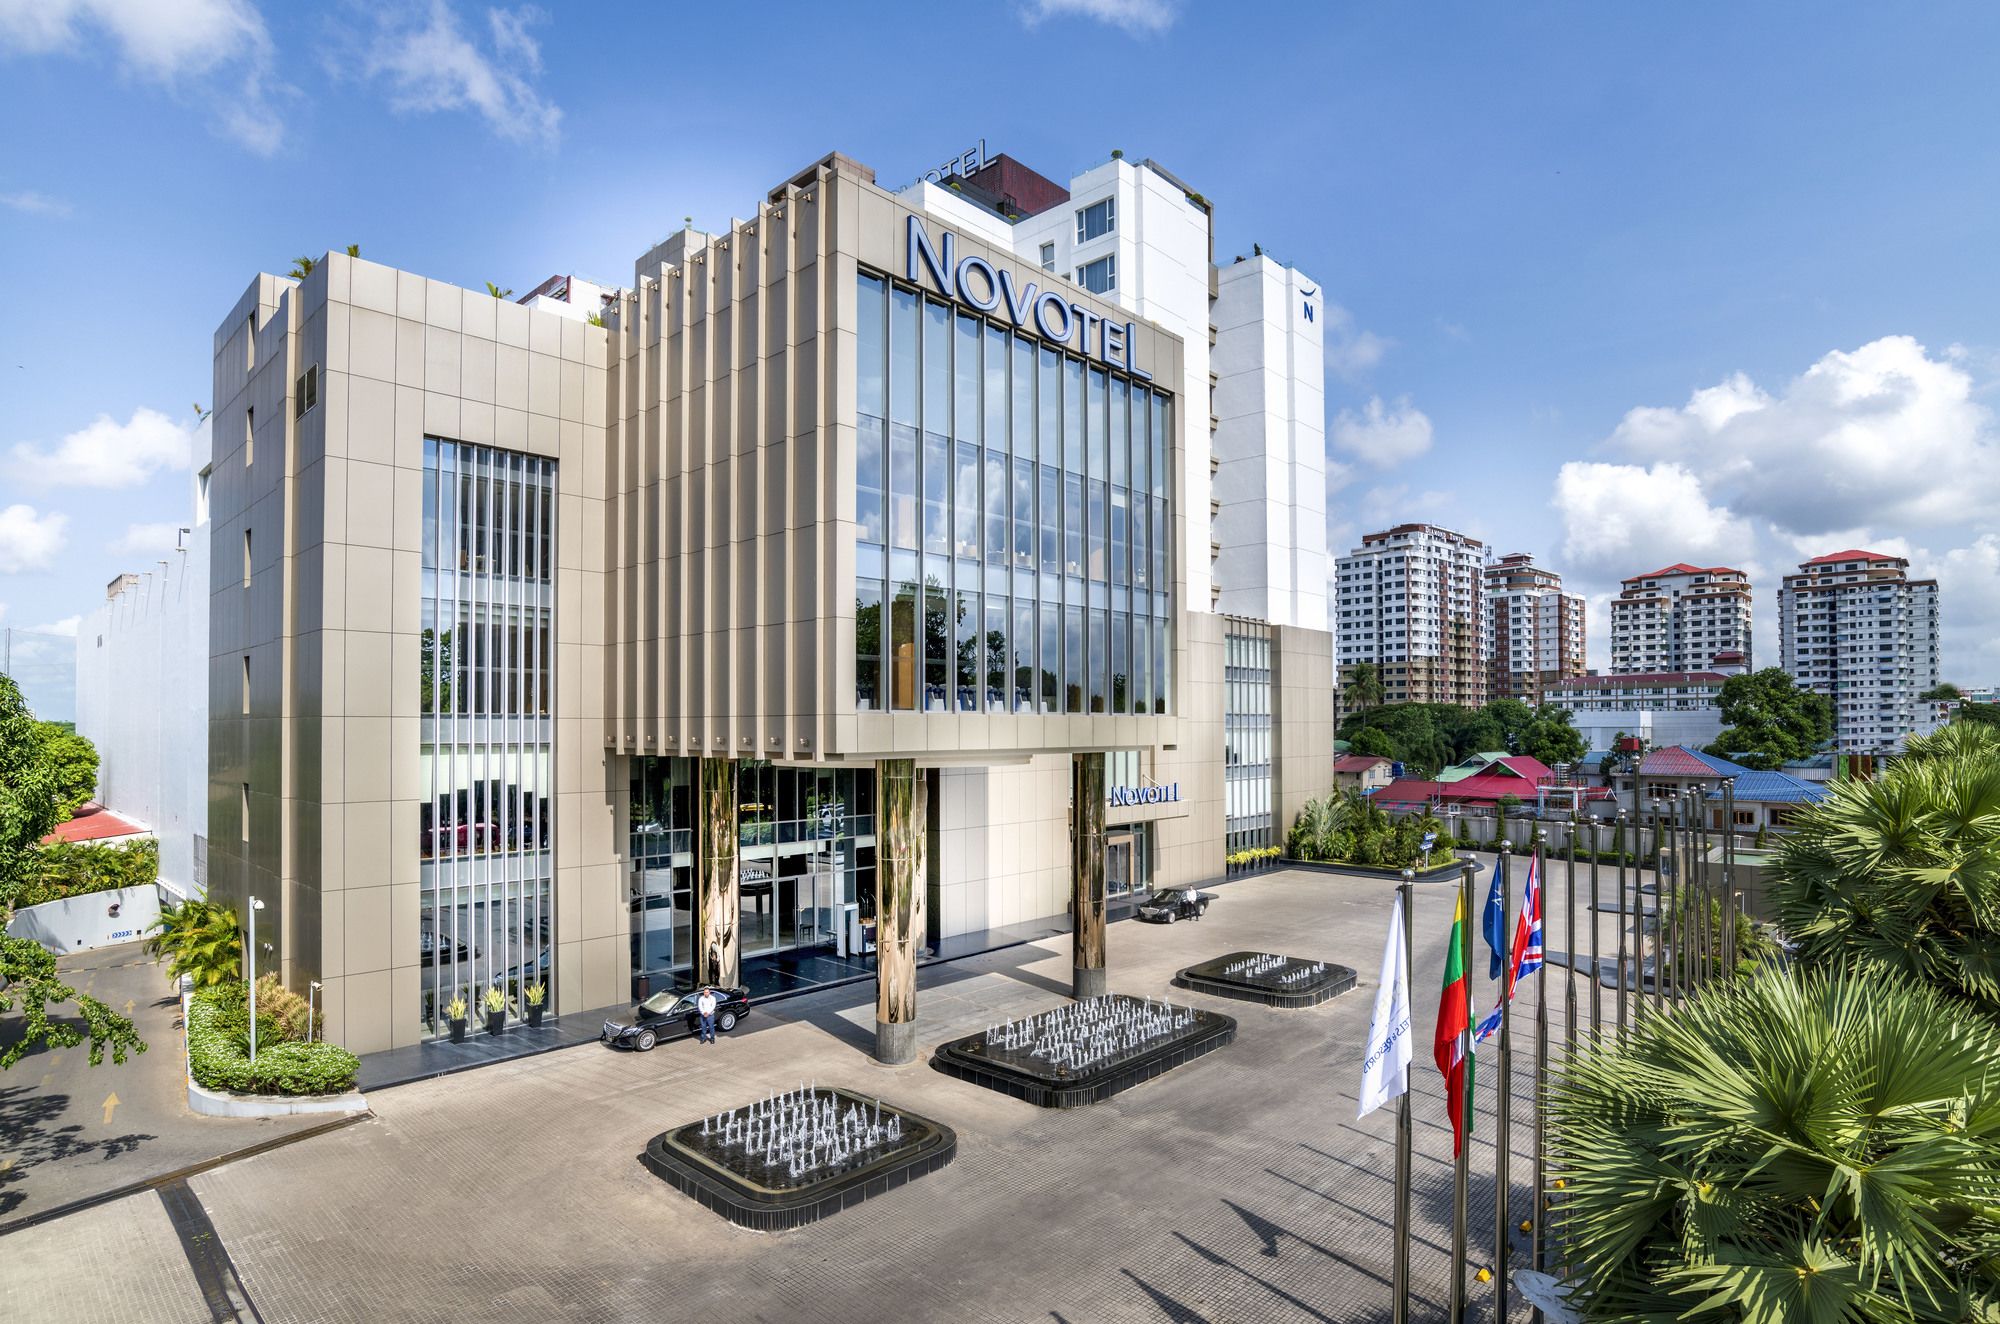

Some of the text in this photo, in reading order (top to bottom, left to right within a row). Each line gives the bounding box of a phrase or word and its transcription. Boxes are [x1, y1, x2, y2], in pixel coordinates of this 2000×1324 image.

[907, 214, 1153, 381] NOVOTEL
[1303, 301, 1313, 323] N
[1110, 783, 1184, 807] NOVOTEL
